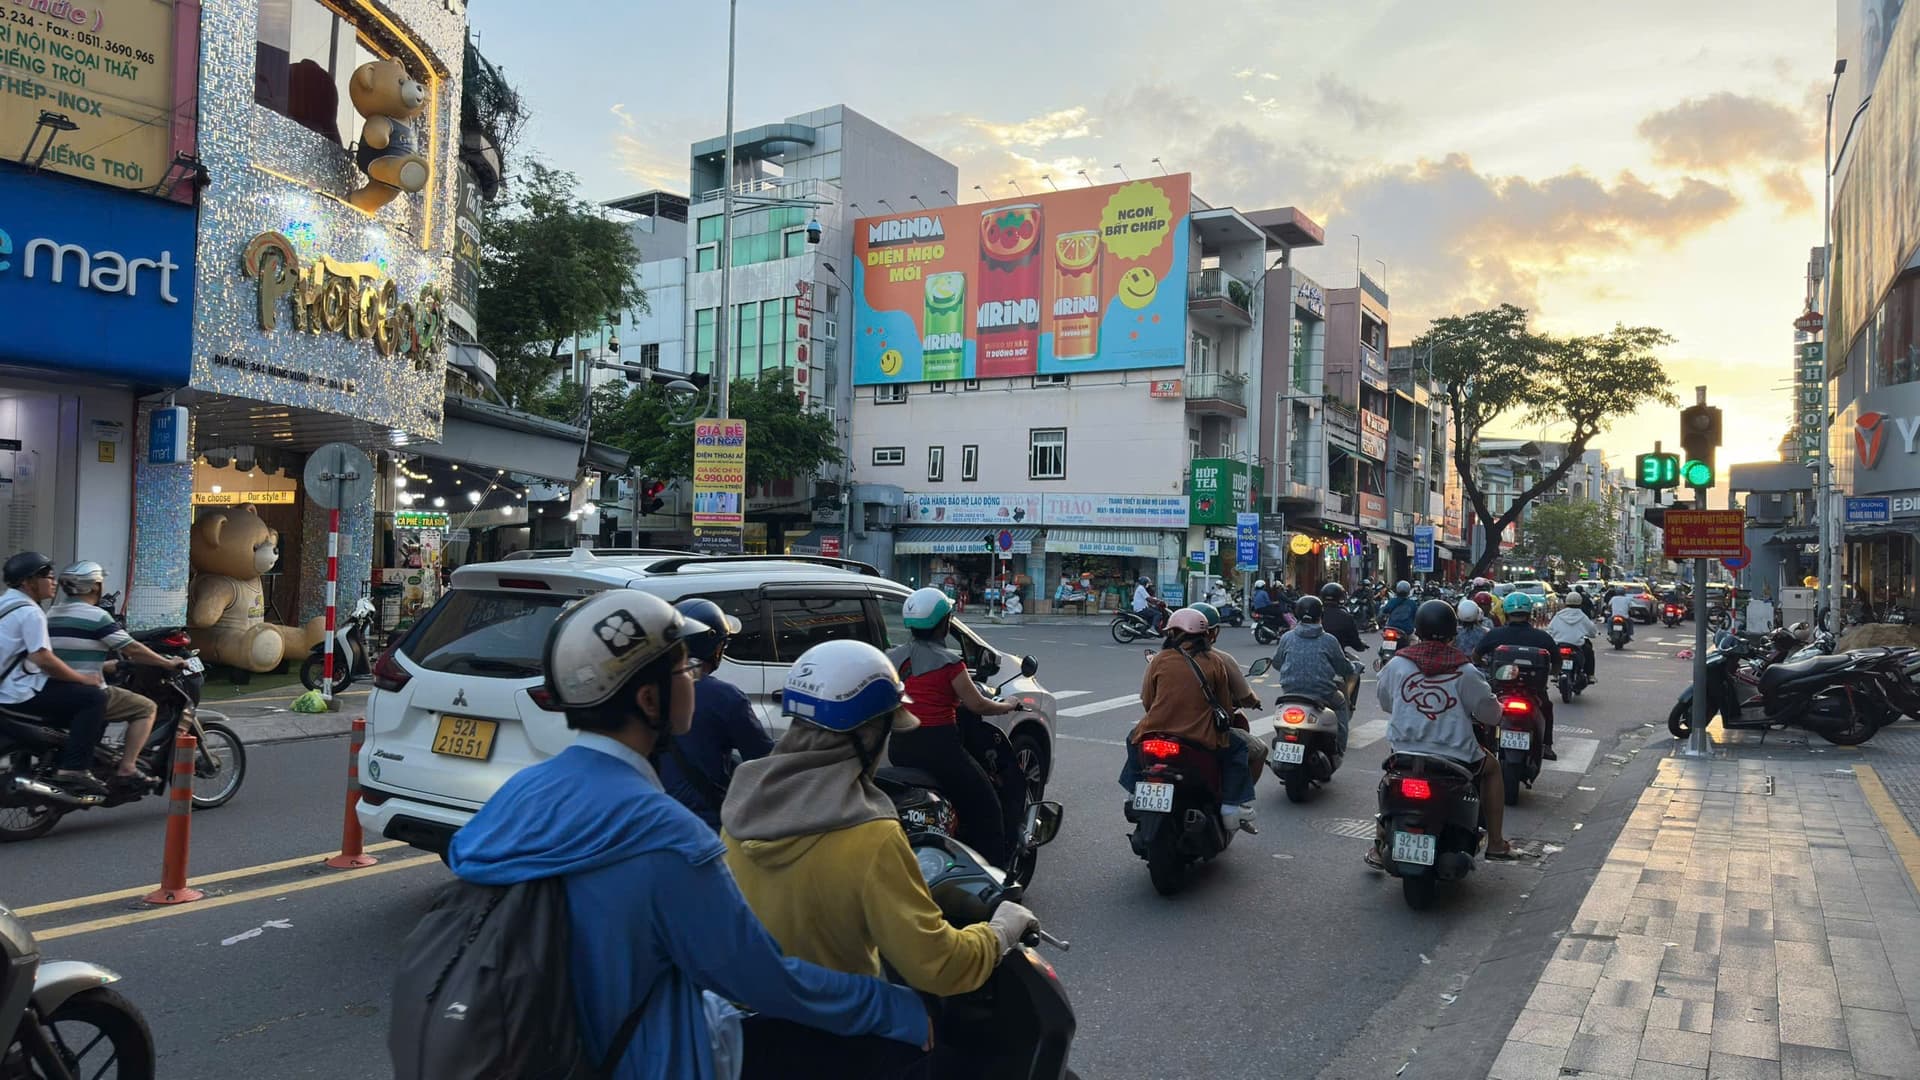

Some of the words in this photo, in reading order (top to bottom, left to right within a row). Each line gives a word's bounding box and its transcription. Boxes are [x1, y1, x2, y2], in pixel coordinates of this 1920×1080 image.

[77, 31, 155, 65] 0511.3690.965
[16, 31, 46, 54] NỘI
[50, 41, 100, 71] NGOẠI
[104, 58, 139, 81] THẤT
[52, 62, 86, 87] TRỜI
[44, 144, 96, 171] IẾNG
[101, 158, 144, 183] TRỜI
[1118, 206, 1154, 220] NGON
[1105, 222, 1128, 236] BẤT
[1131, 217, 1166, 233] CHẤP
[868, 247, 904, 267] DIỆN
[907, 244, 945, 264] MẠO
[24, 238, 179, 303] mart
[889, 263, 922, 282] MỚI
[1643, 457, 1673, 482] 31
[696, 474, 743, 483] 4.990.000
[1195, 478, 1217, 488] TEA
[207, 494, 231, 503] choose
[247, 492, 260, 501] Our
[261, 492, 279, 502] style
[919, 495, 931, 505] CỬA
[932, 495, 946, 505] HÀNG
[961, 495, 970, 507] HỘ
[971, 496, 982, 505] LAO
[984, 495, 1000, 507] ĐỘNG
[406, 516, 418, 526] PHÊ
[453, 720, 477, 737] 92A
[438, 735, 483, 756] 219.51
[1140, 784, 1167, 798] 43-E1
[1135, 797, 1169, 810] 604.83
[907, 810, 926, 824] TOM
[1399, 834, 1430, 848] 92-L8
